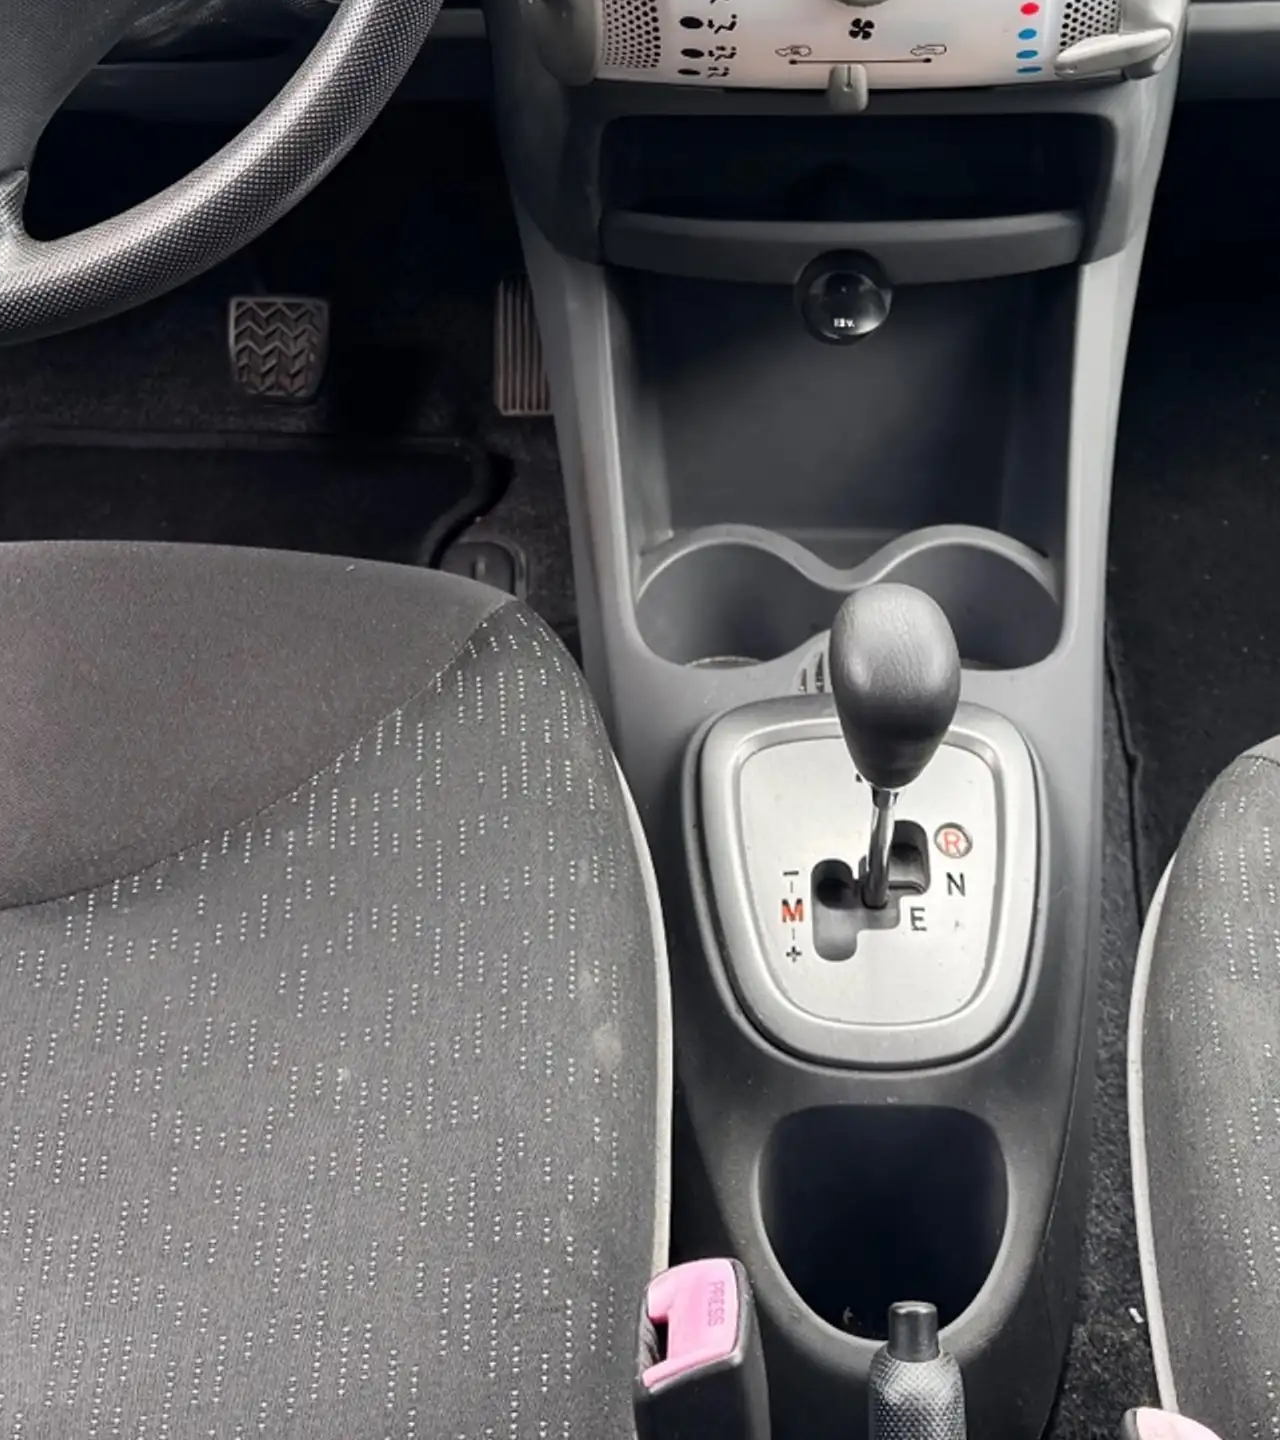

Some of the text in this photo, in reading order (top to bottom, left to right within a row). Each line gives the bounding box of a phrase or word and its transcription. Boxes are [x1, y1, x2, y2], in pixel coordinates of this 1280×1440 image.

[946, 872, 966, 897] N
[781, 898, 804, 923] M
[910, 906, 927, 931] E
[707, 1280, 725, 1327] PRESS
